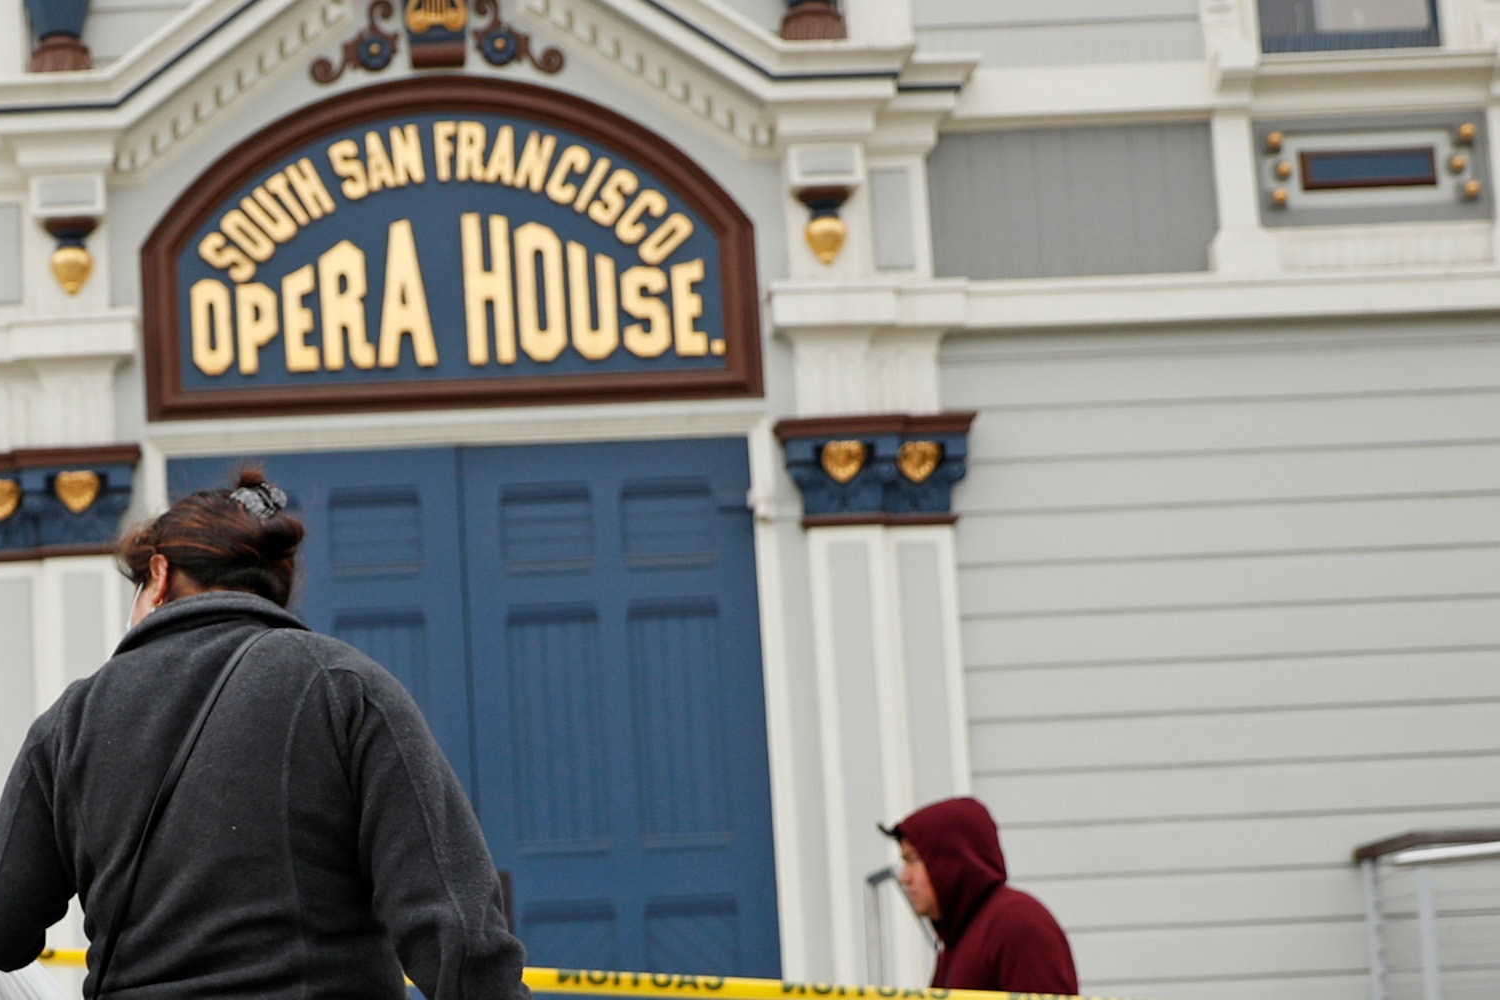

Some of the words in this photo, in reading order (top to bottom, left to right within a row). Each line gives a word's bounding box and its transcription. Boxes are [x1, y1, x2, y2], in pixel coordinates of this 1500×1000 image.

[199, 156, 336, 282] SOUTH
[327, 123, 426, 200] SAN
[432, 120, 694, 266] FRANCISCO
[190, 218, 439, 376] OPERA
[460, 212, 727, 367] HOUSE.
